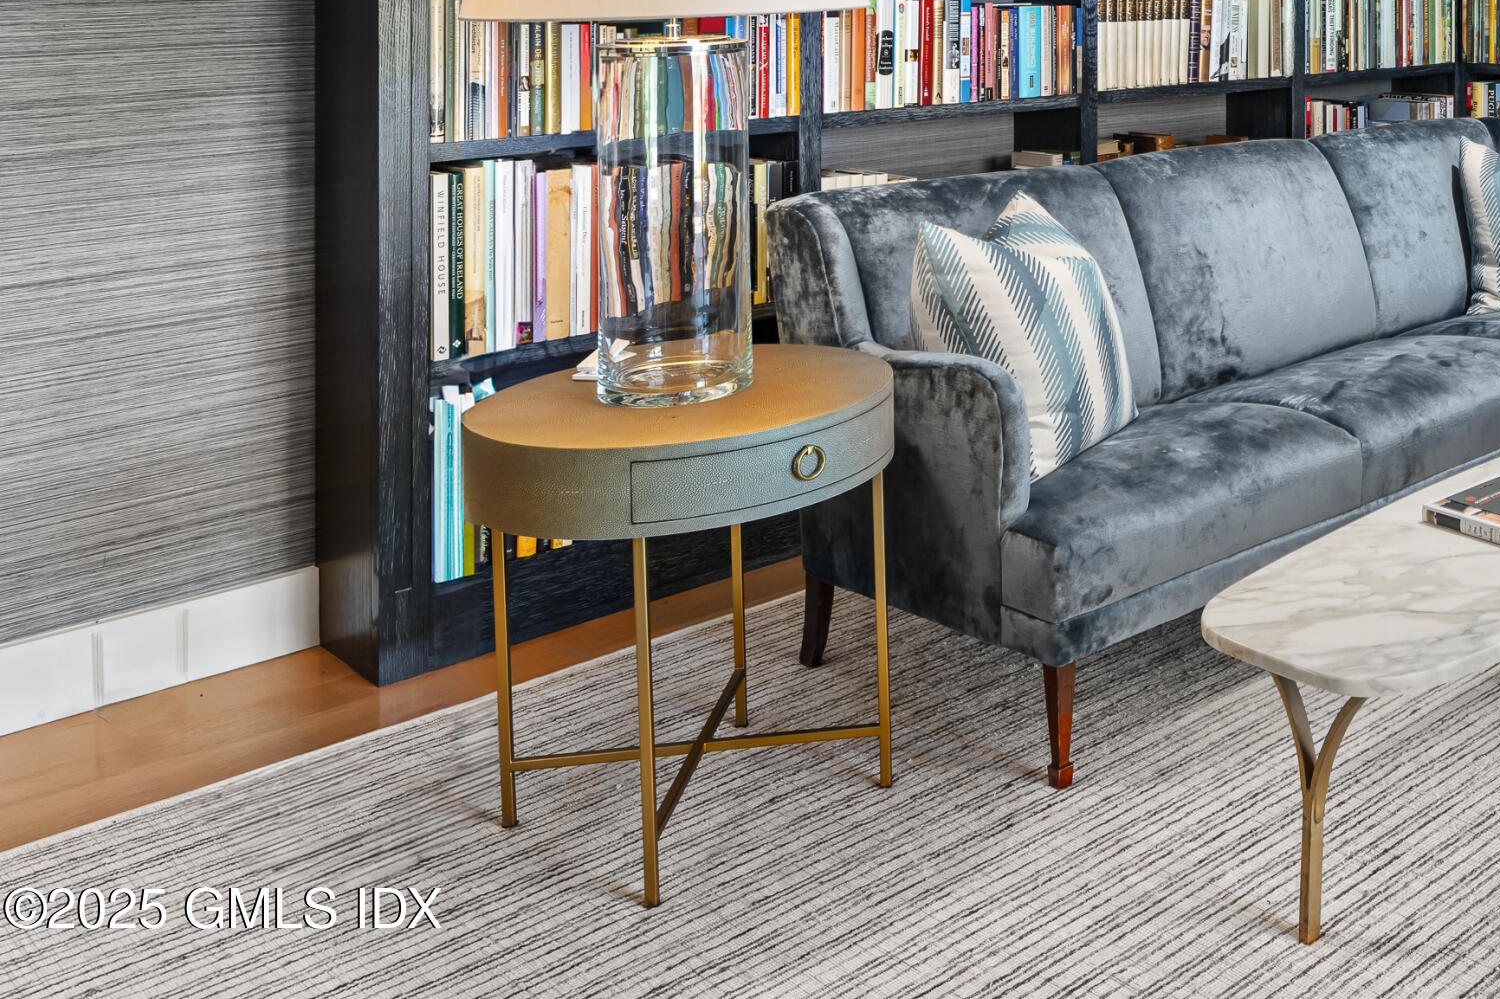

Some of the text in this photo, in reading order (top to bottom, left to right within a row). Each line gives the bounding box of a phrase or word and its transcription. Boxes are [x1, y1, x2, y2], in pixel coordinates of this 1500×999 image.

[534, 24, 543, 89] ALAIN DE BOTTON
[436, 190, 446, 296] WINFIELD HOUSE
[456, 183, 464, 300] GREAT HOUSES OF IRELAND
